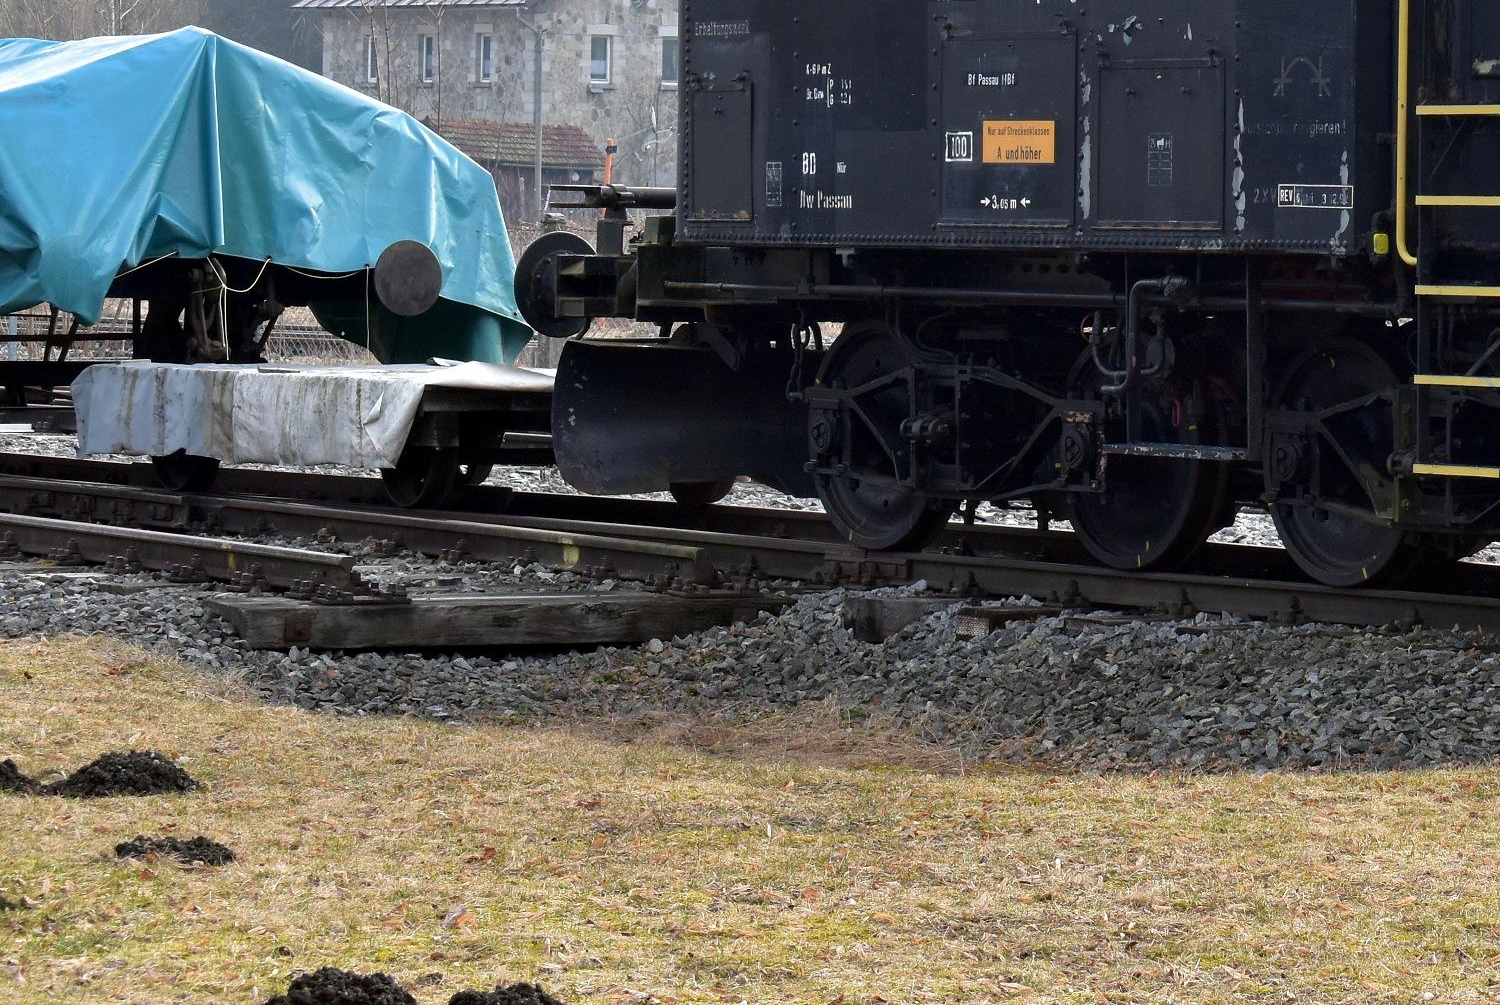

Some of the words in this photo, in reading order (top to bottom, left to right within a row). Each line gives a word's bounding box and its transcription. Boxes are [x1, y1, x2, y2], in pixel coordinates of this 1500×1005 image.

[967, 73, 976, 86] Bf
[978, 73, 999, 86] Passau
[951, 136, 967, 158] 100
[996, 146, 1002, 160] A
[1005, 146, 1019, 160] und
[1020, 145, 1042, 160] höher
[816, 190, 853, 209] Passau
[1279, 189, 1294, 202] REV
